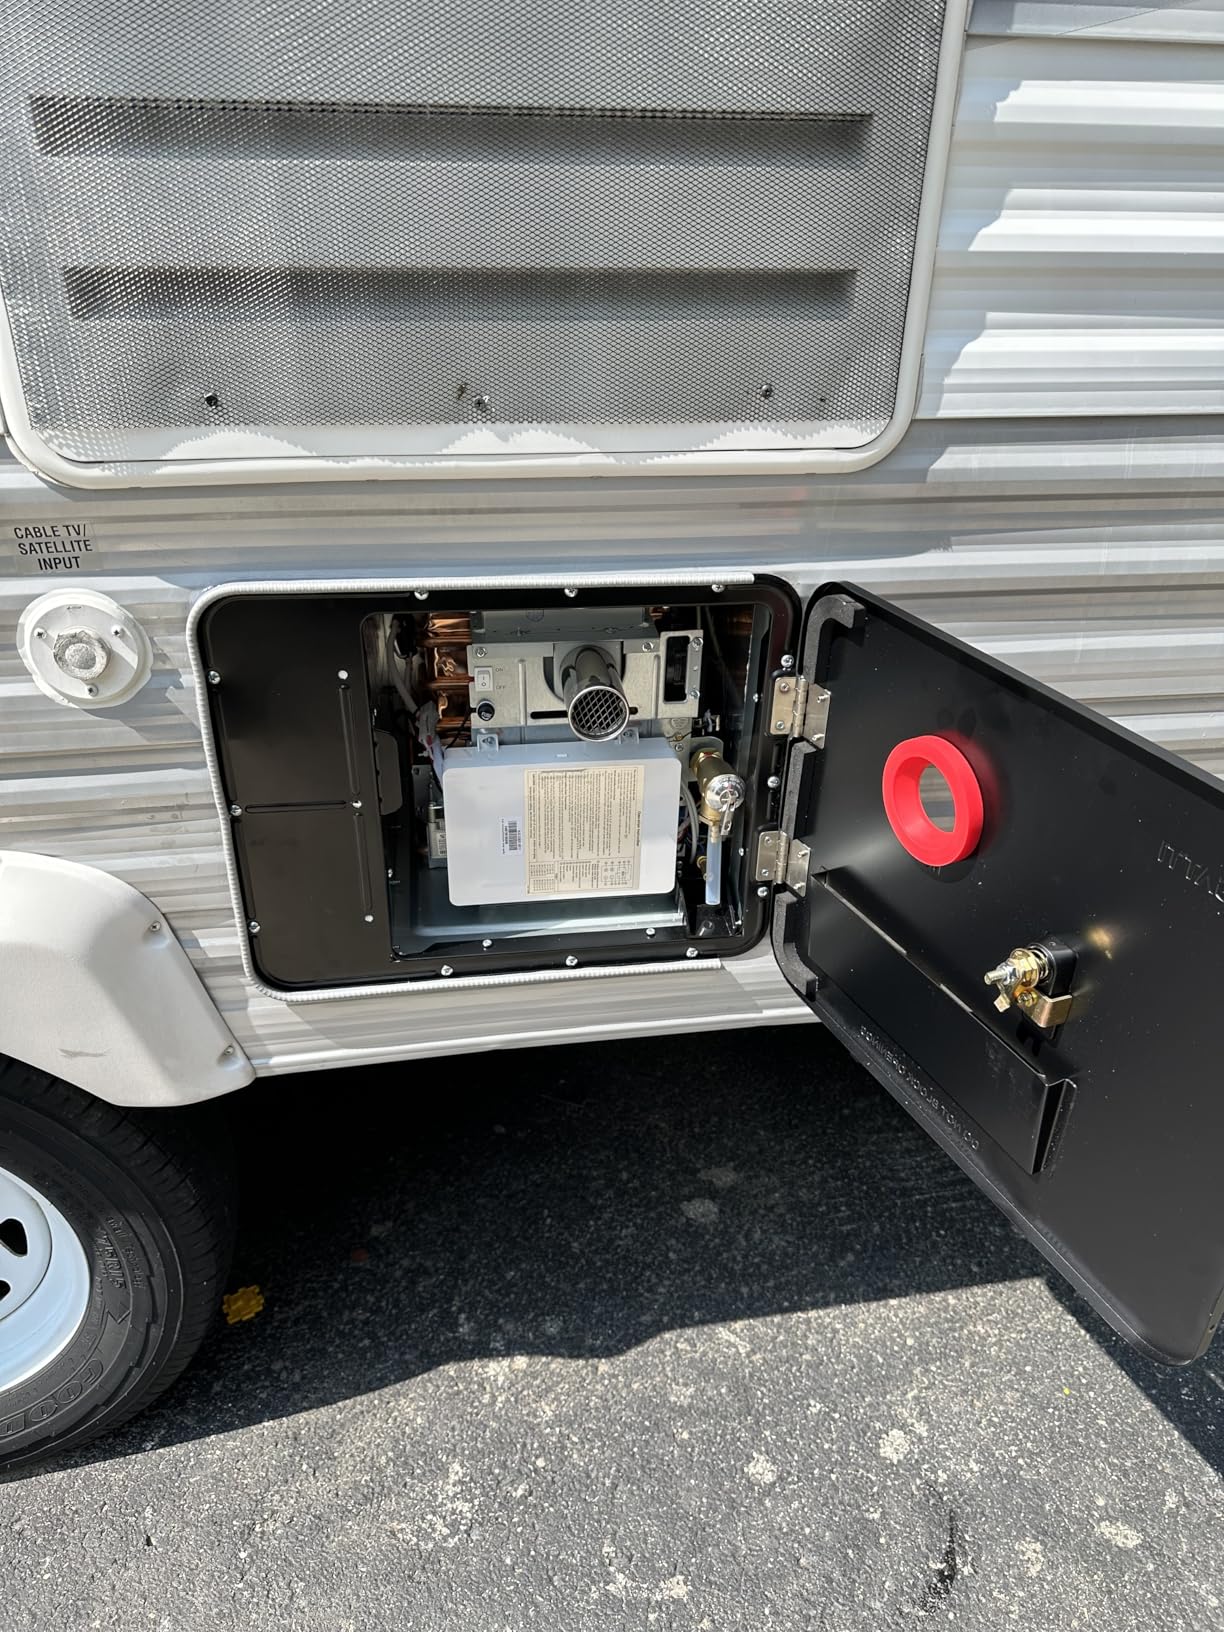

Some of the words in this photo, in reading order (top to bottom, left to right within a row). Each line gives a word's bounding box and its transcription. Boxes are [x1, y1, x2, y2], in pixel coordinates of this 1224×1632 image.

[14, 526, 61, 539] CABLE
[62, 523, 86, 537] TV/
[18, 539, 93, 555] SATELLITE
[37, 556, 80, 571] INPUT
